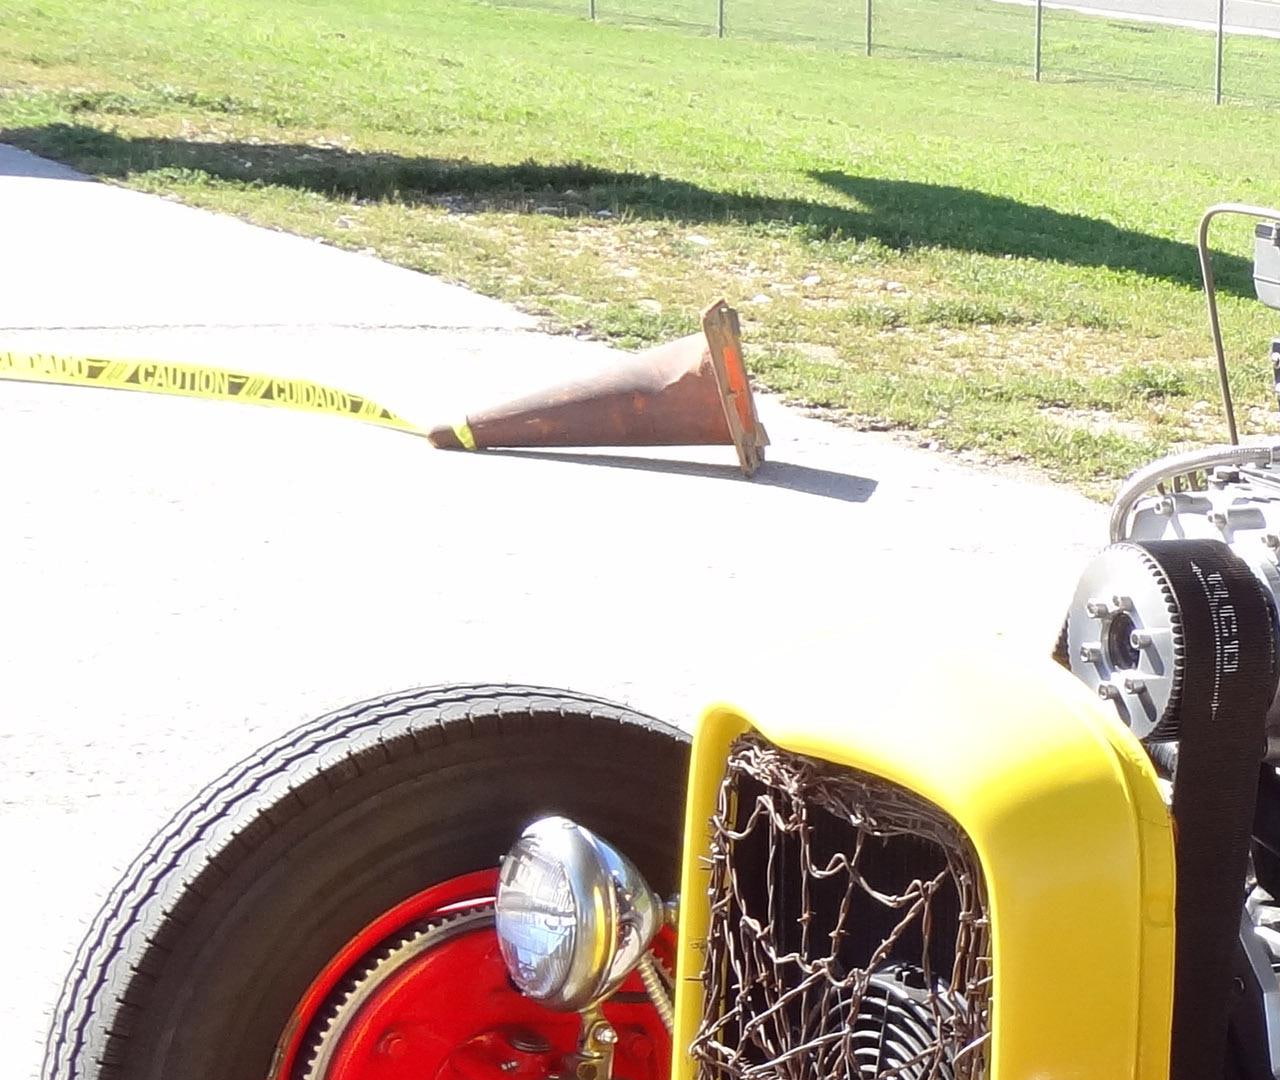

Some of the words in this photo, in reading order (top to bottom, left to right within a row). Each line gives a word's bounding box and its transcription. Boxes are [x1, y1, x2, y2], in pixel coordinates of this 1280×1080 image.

[0, 351, 89, 379] UIDADO
[138, 363, 229, 396] CAUTION
[271, 379, 352, 412] CUIDADO
